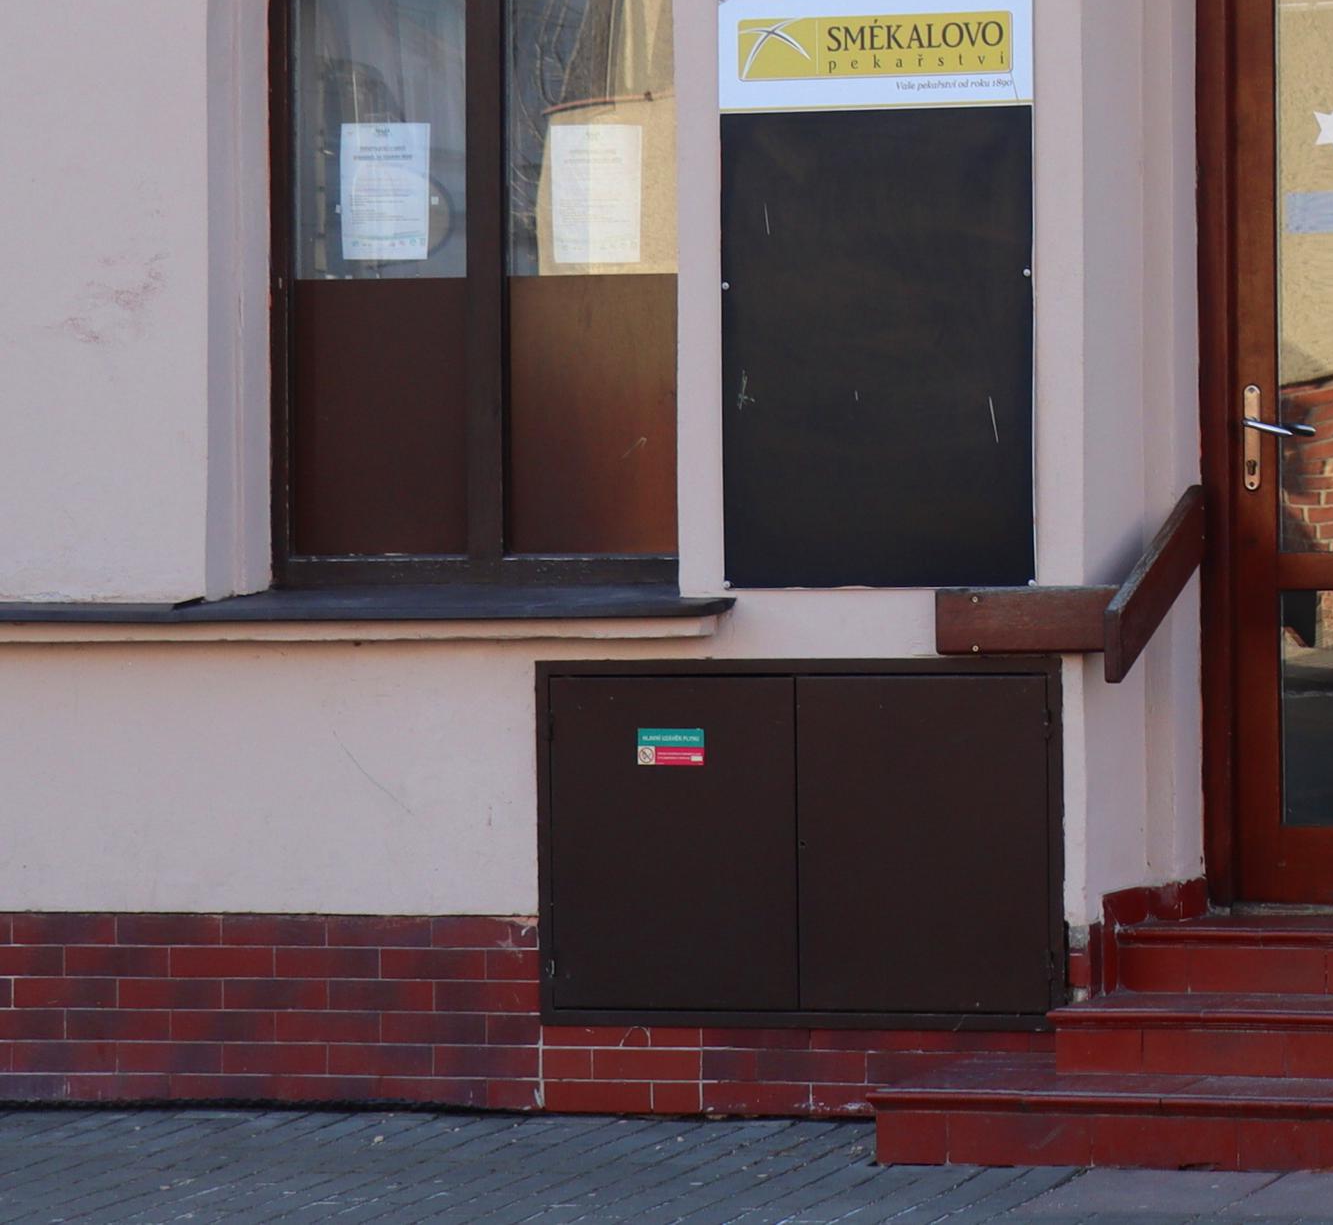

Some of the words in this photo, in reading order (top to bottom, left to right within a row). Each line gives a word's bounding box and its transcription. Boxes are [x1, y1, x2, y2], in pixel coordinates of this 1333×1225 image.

[827, 19, 1002, 51] SMÉKALOVO
[828, 52, 1004, 73] pekařství
[896, 81, 915, 91] Vaše
[917, 80, 956, 91] pekařství
[958, 80, 968, 89] od
[970, 79, 991, 88] roku
